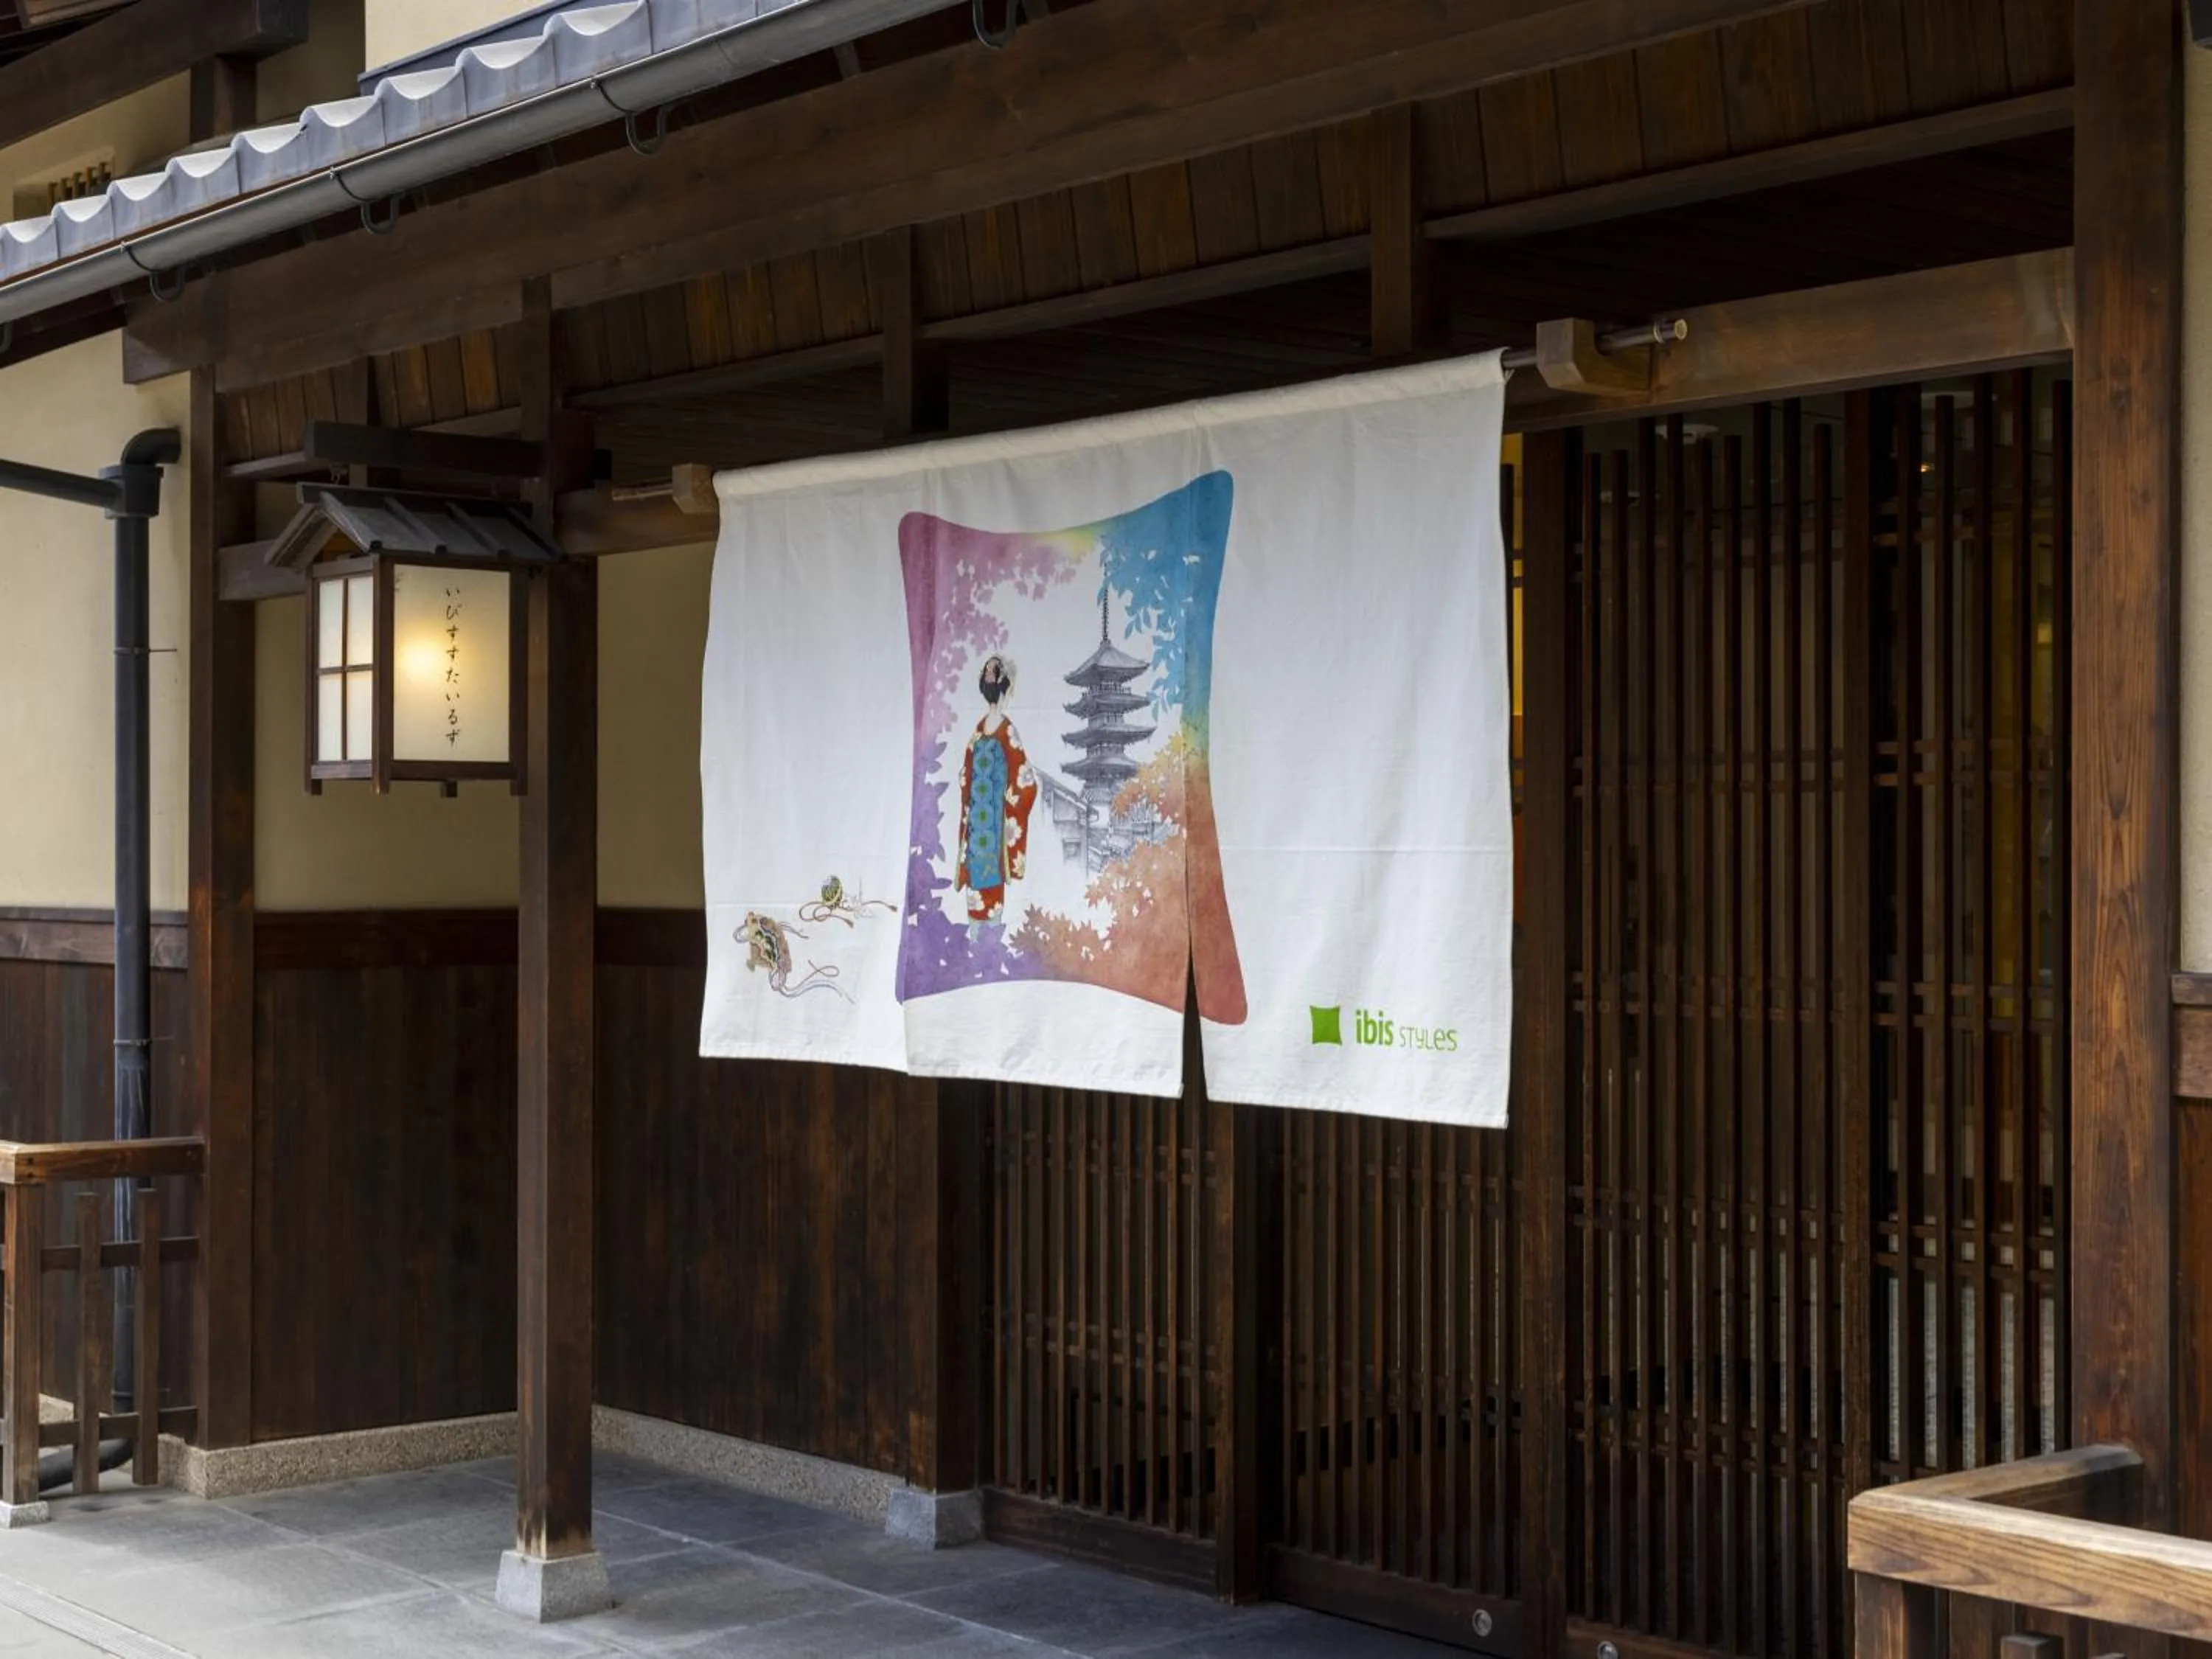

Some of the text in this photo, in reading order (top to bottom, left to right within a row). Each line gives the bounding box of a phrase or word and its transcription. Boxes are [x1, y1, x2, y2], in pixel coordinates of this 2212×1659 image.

[445, 588, 462, 747] いびすすたいるず
[1355, 1009, 1394, 1046] ibis
